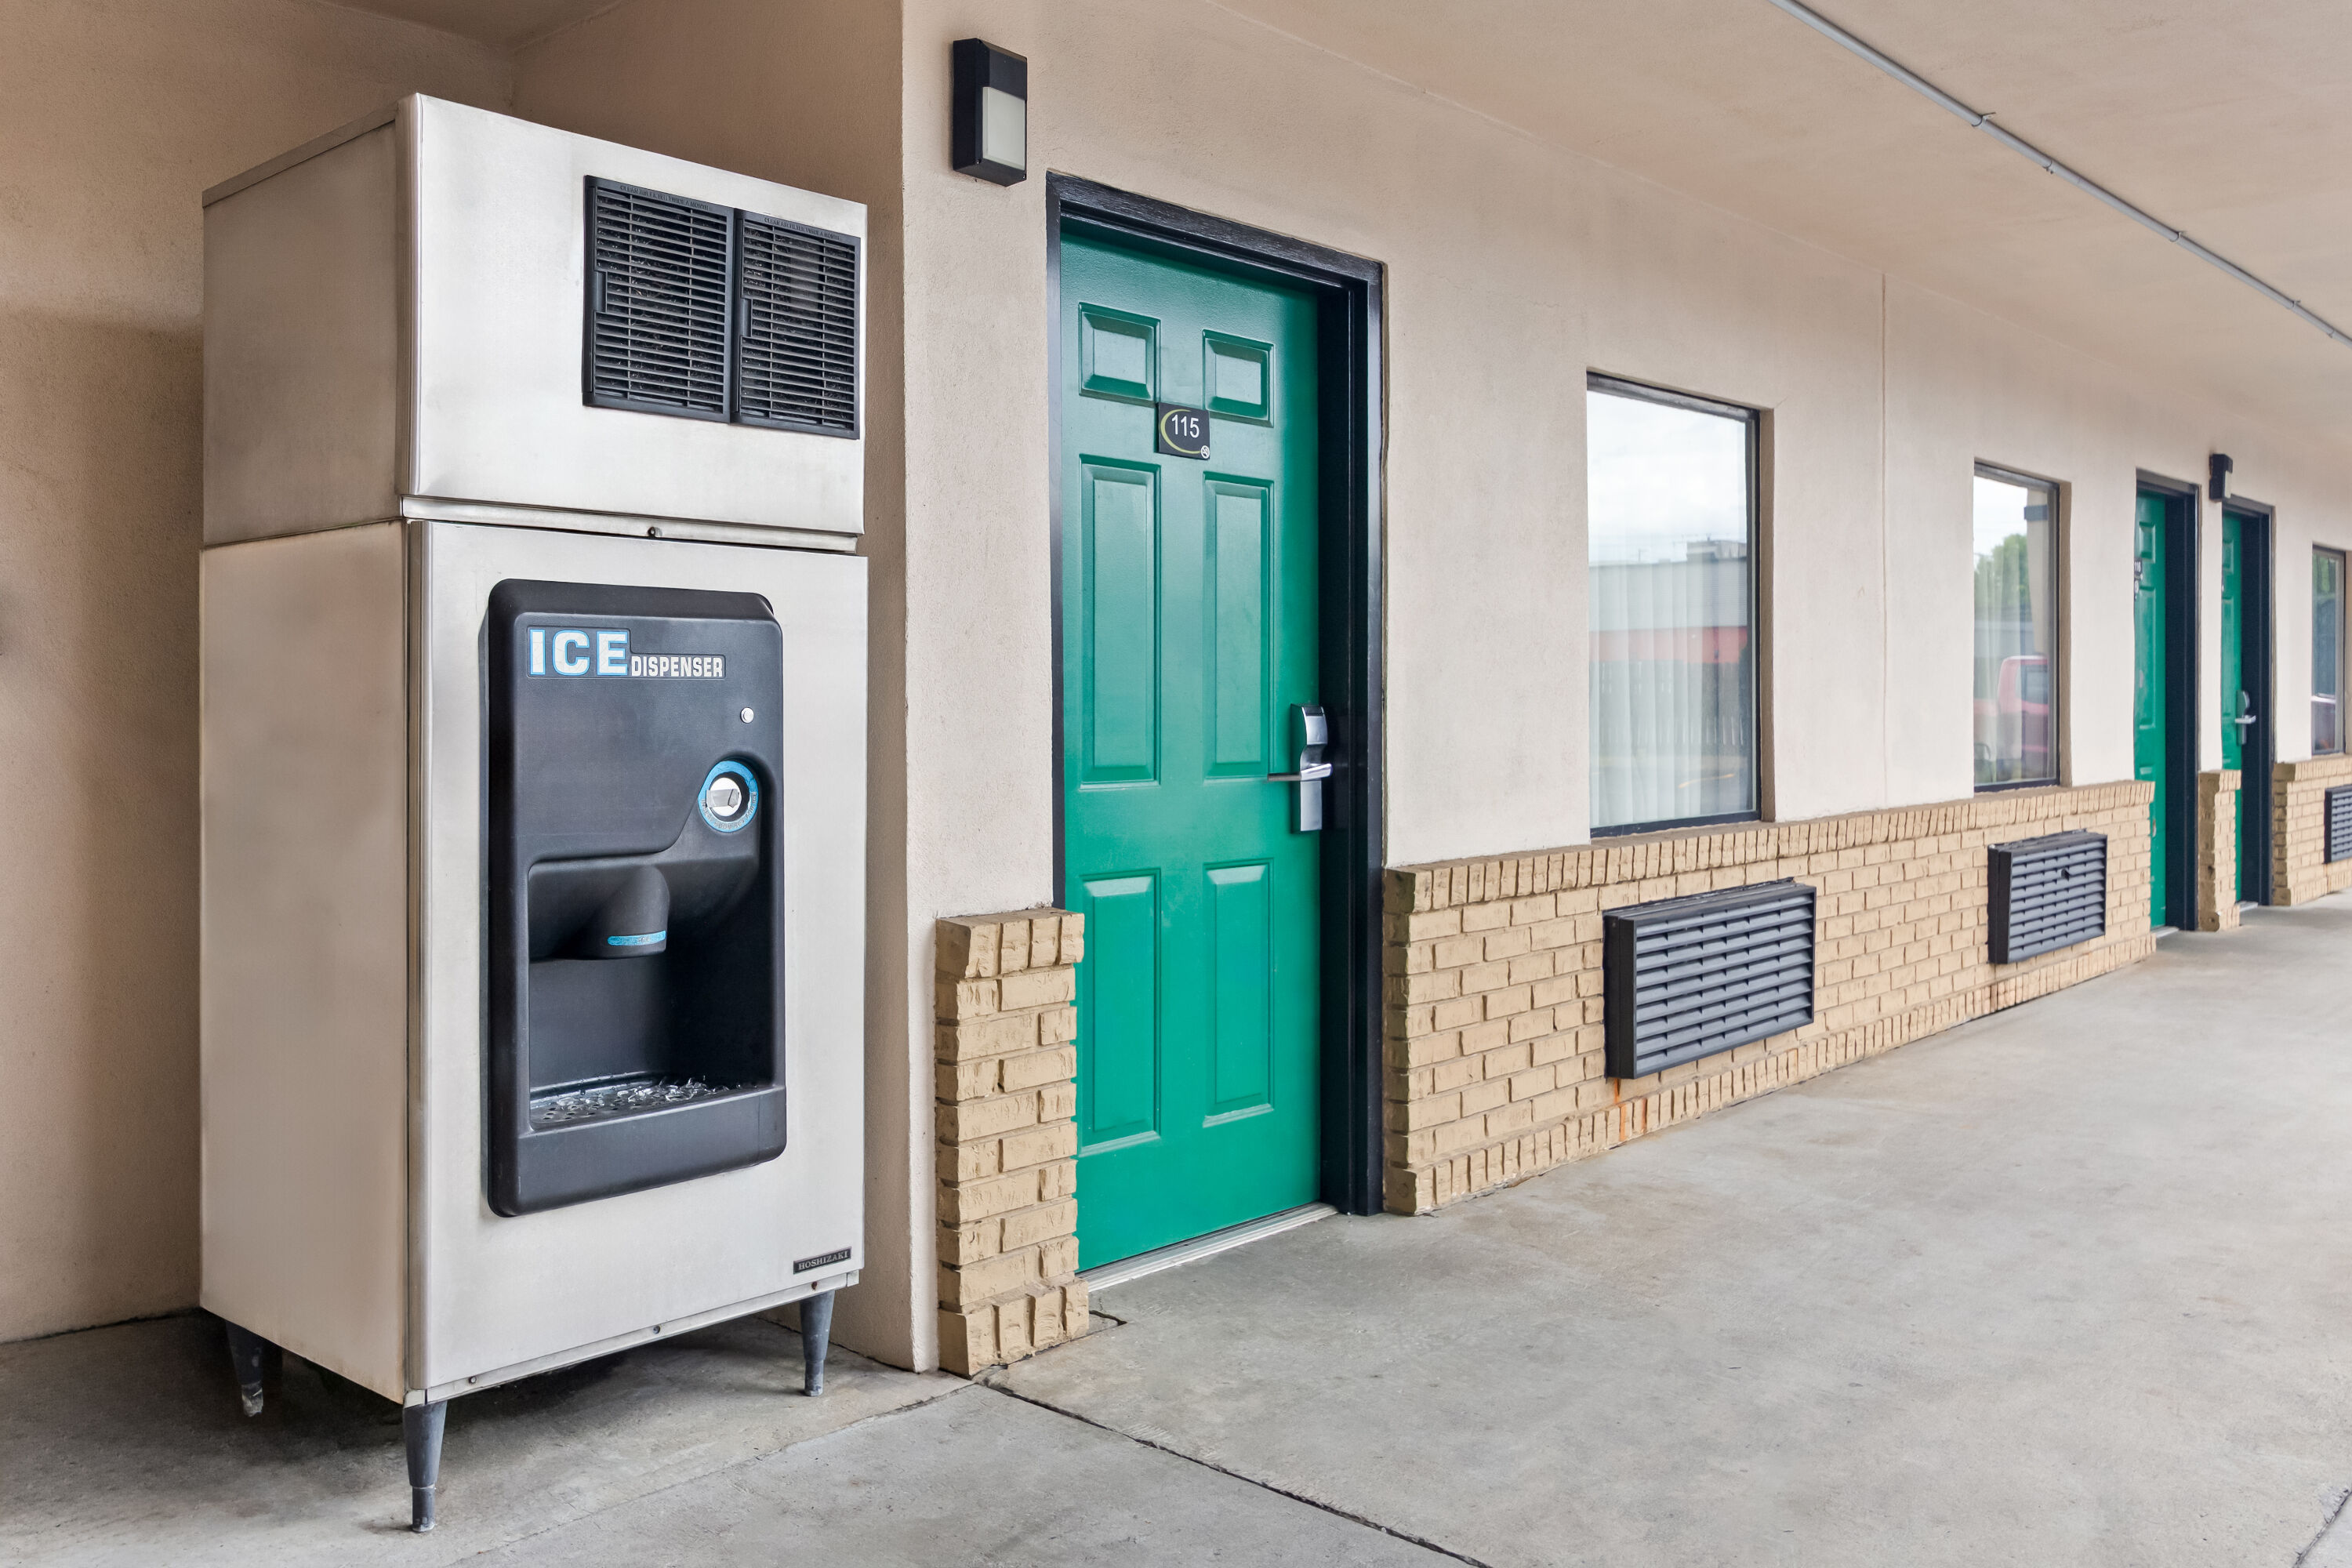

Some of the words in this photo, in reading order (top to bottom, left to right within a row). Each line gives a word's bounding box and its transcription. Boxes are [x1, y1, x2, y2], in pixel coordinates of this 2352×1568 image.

[1171, 414, 1200, 438] 115
[530, 629, 628, 676] ICE
[631, 655, 723, 677] DISPENSER
[798, 1250, 848, 1270] HOSHIZAKI
